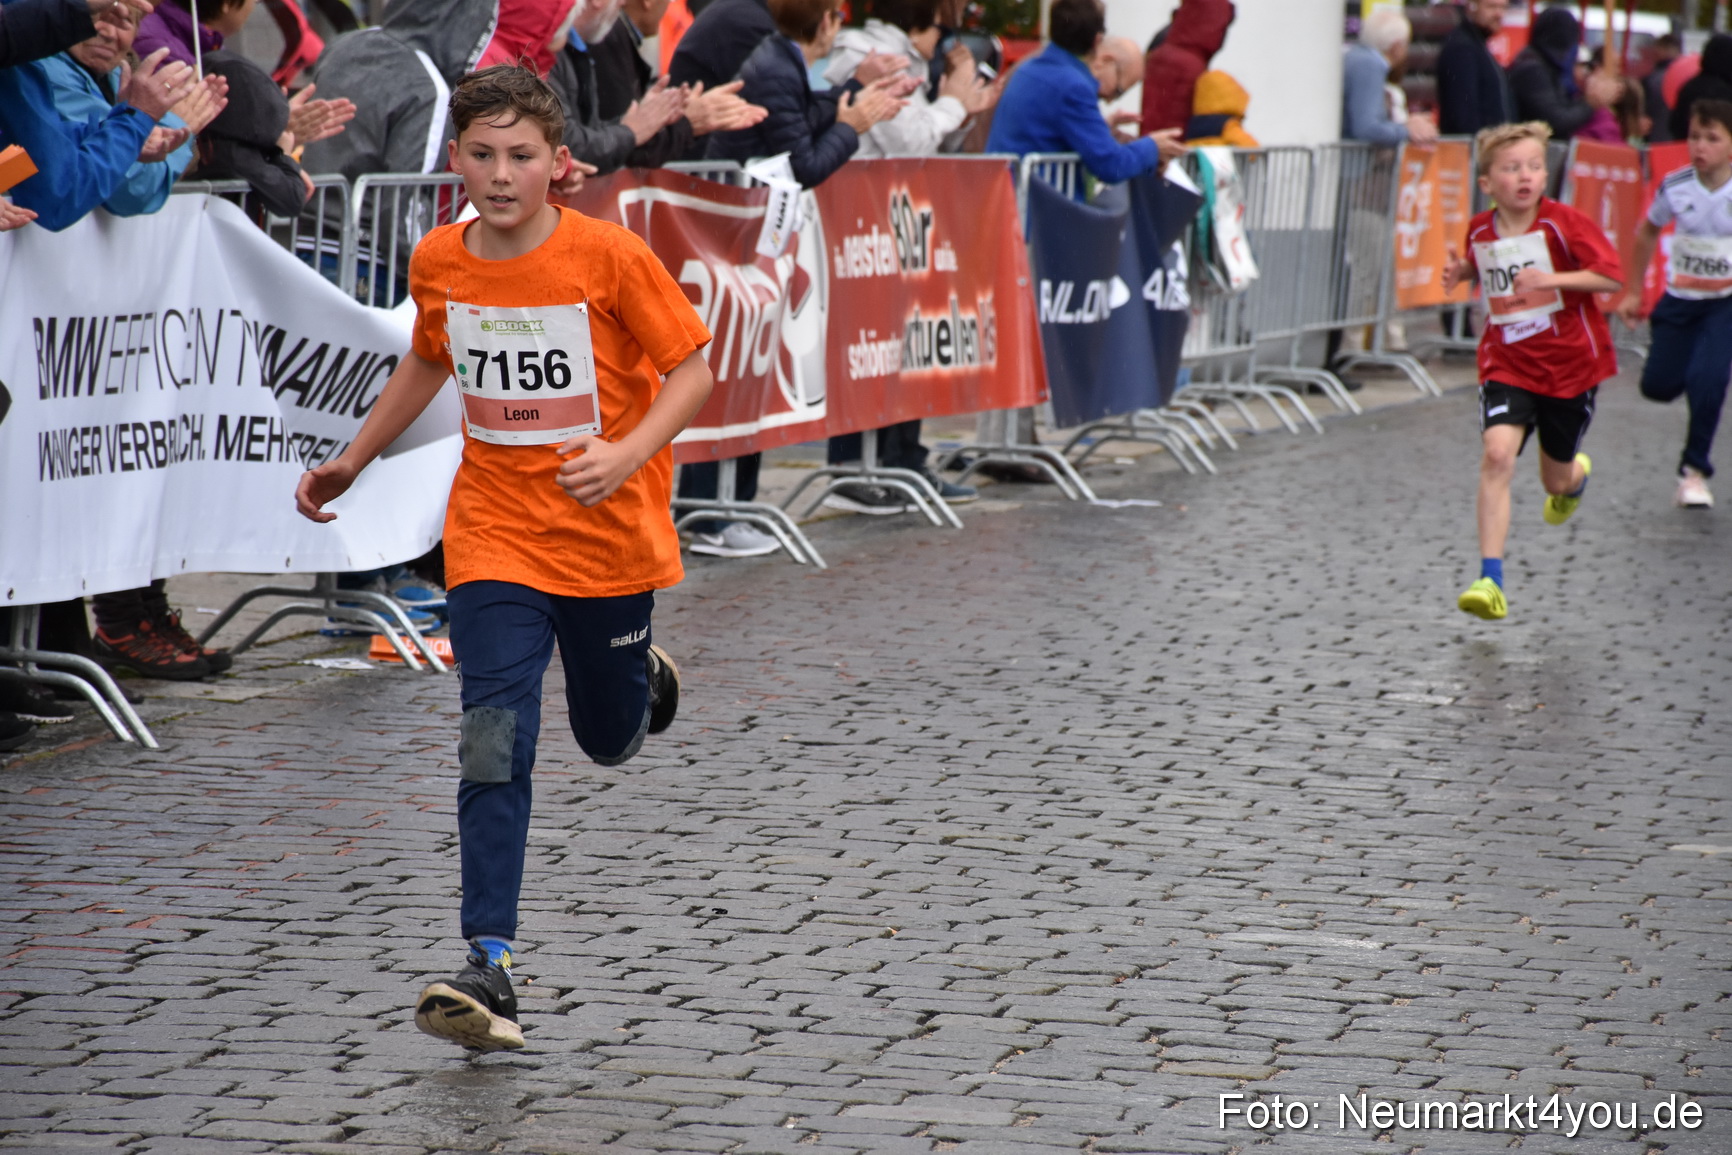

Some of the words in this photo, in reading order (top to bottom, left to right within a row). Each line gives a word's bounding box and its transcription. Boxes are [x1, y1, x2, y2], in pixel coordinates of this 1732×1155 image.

[495, 320, 545, 332] BOCK
[33, 316, 108, 400] BMW
[467, 348, 572, 391] 7156
[503, 406, 540, 421] Leon
[38, 426, 102, 482] WNIGER
[105, 413, 206, 472] VERBRUCH.
